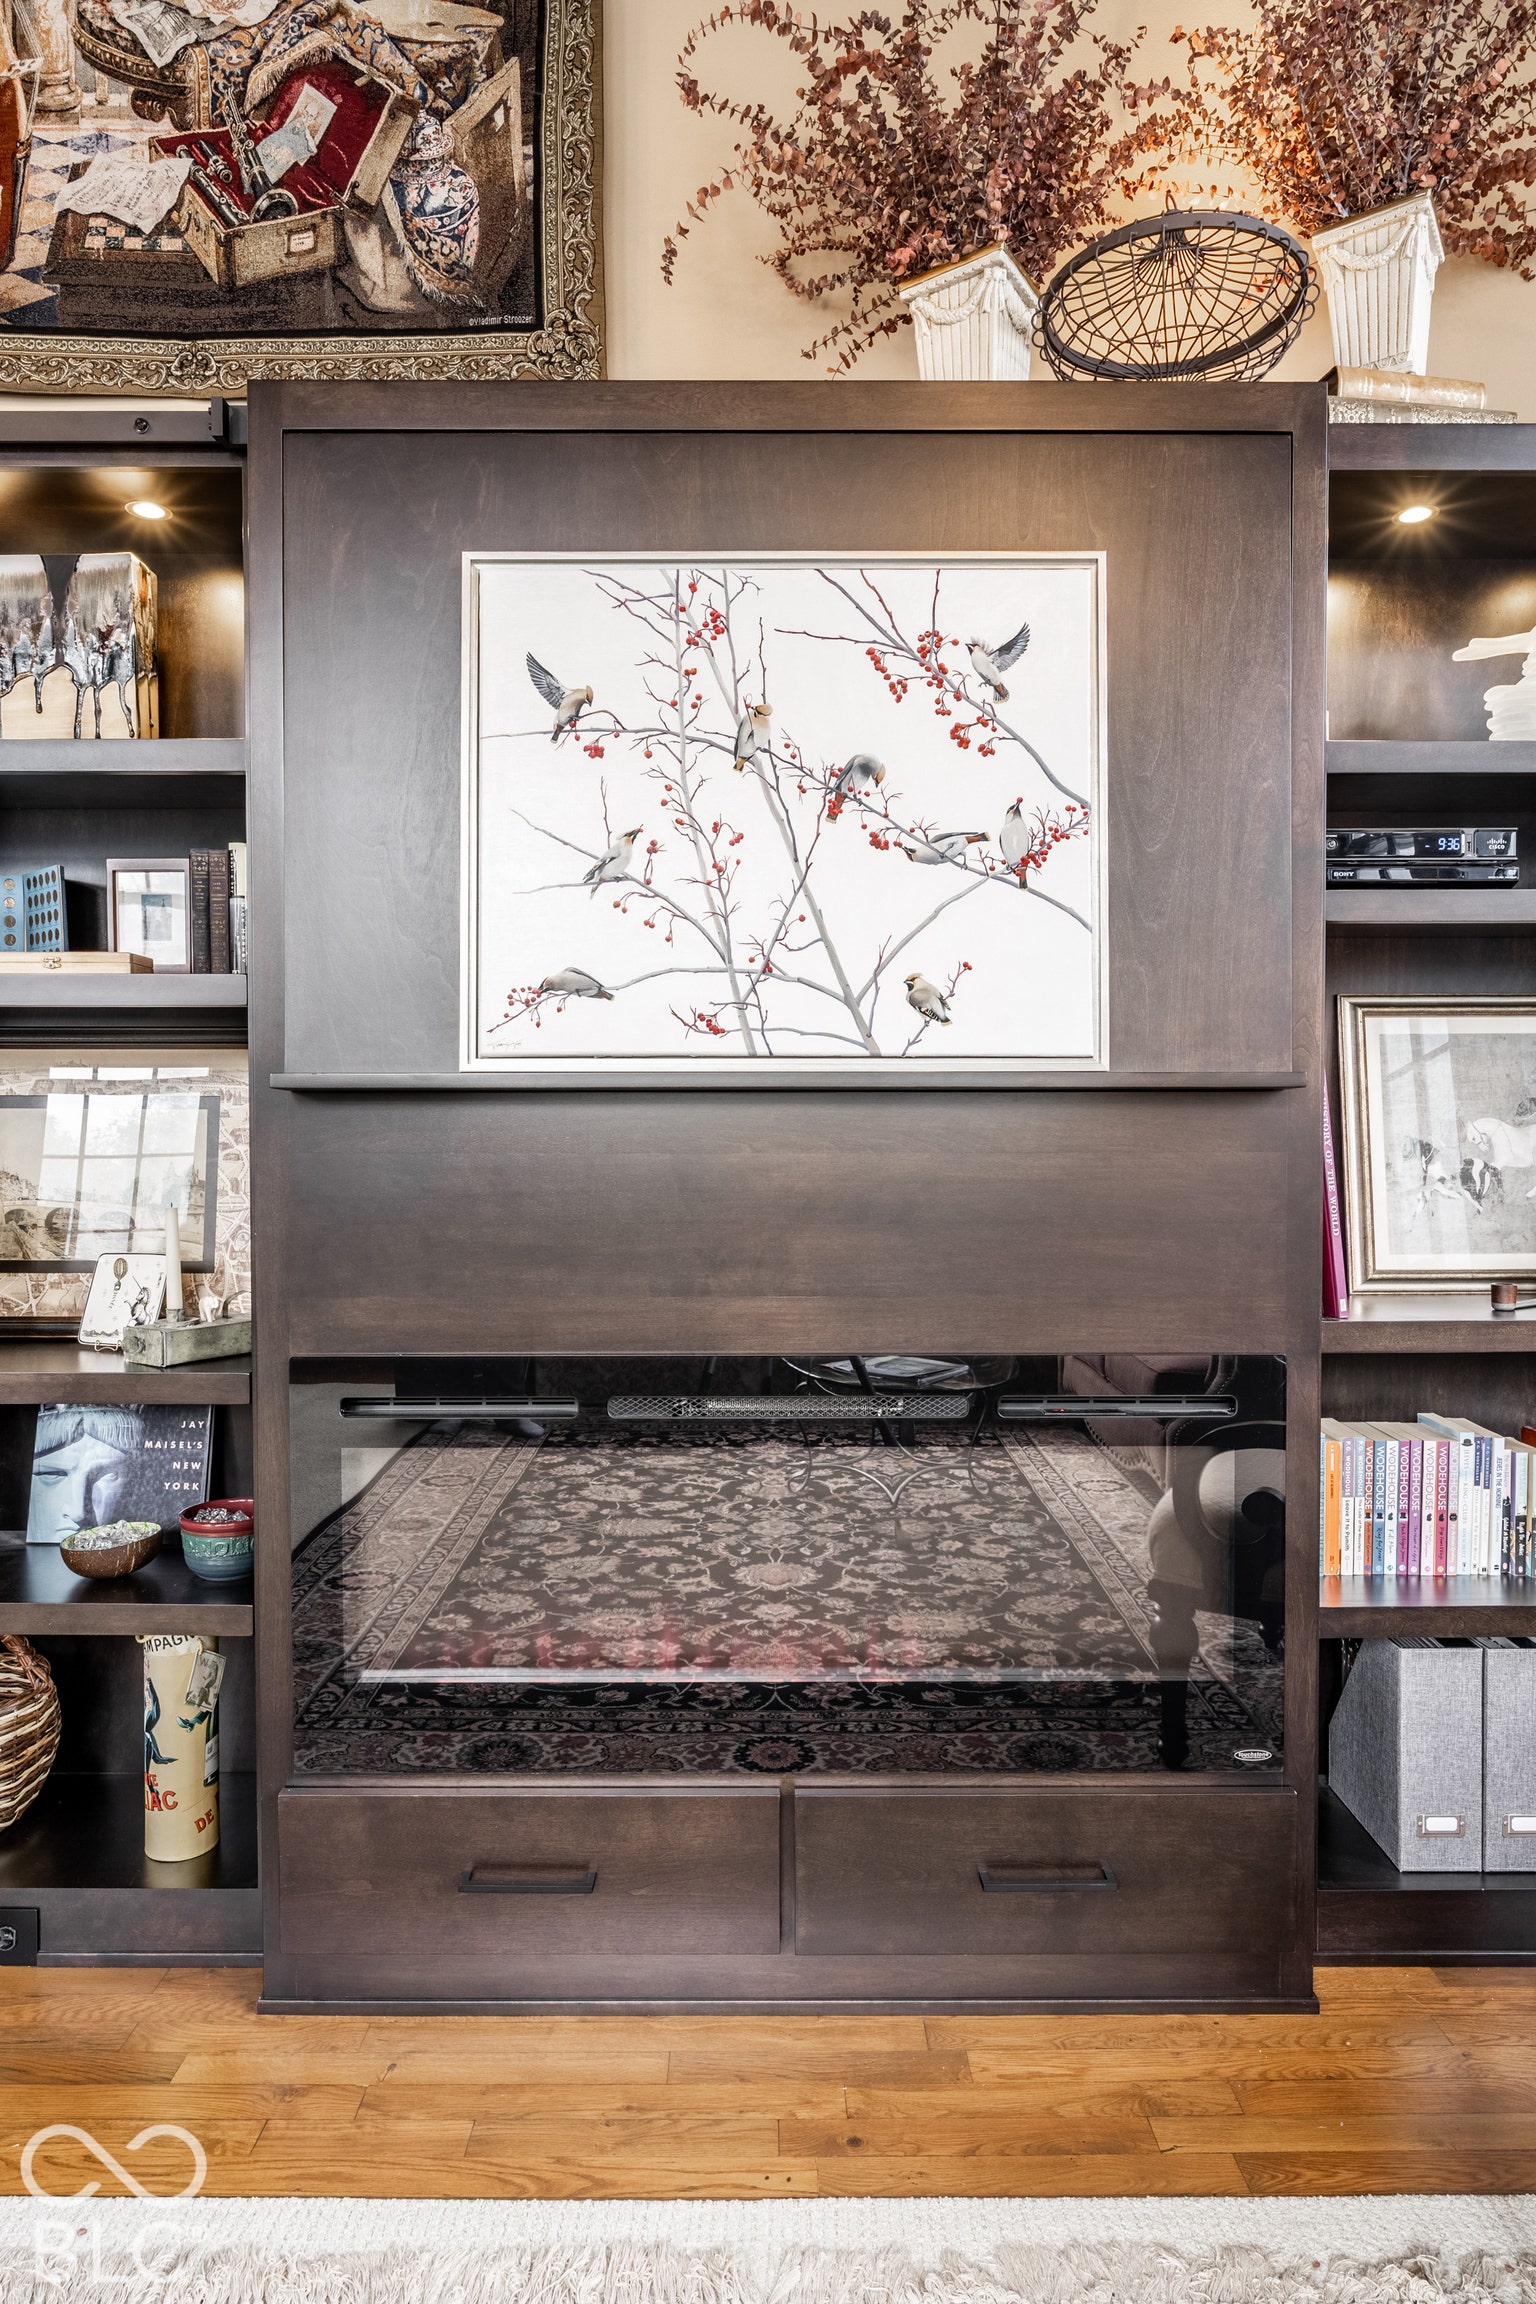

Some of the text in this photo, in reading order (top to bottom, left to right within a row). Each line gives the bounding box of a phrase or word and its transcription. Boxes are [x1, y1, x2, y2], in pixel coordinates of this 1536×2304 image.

[1438, 837, 1460, 850] 9:36
[1325, 1149, 1334, 1166] OF
[1327, 1168, 1336, 1192] THE
[1330, 1195, 1340, 1236] WORLD
[144, 1440, 204, 1449] MAISEL'S
[180, 1420, 205, 1429] JAY
[163, 1481, 200, 1491] YORK
[172, 1461, 202, 1470] NEW
[1365, 1446, 1373, 1509] WODEHOUSE
[1375, 1446, 1384, 1510] WODEHOUSE
[1387, 1446, 1396, 1509] WODEHOUSE
[1400, 1446, 1408, 1509] WODEHOUSE
[1412, 1447, 1420, 1510] WODEHOUSE
[1425, 1447, 1434, 1510] WODEHOUSE
[1437, 1447, 1447, 1510] WODEHOUSE
[1450, 1447, 1459, 1510] WODEHOUSE
[194, 1808, 214, 1833] DE
